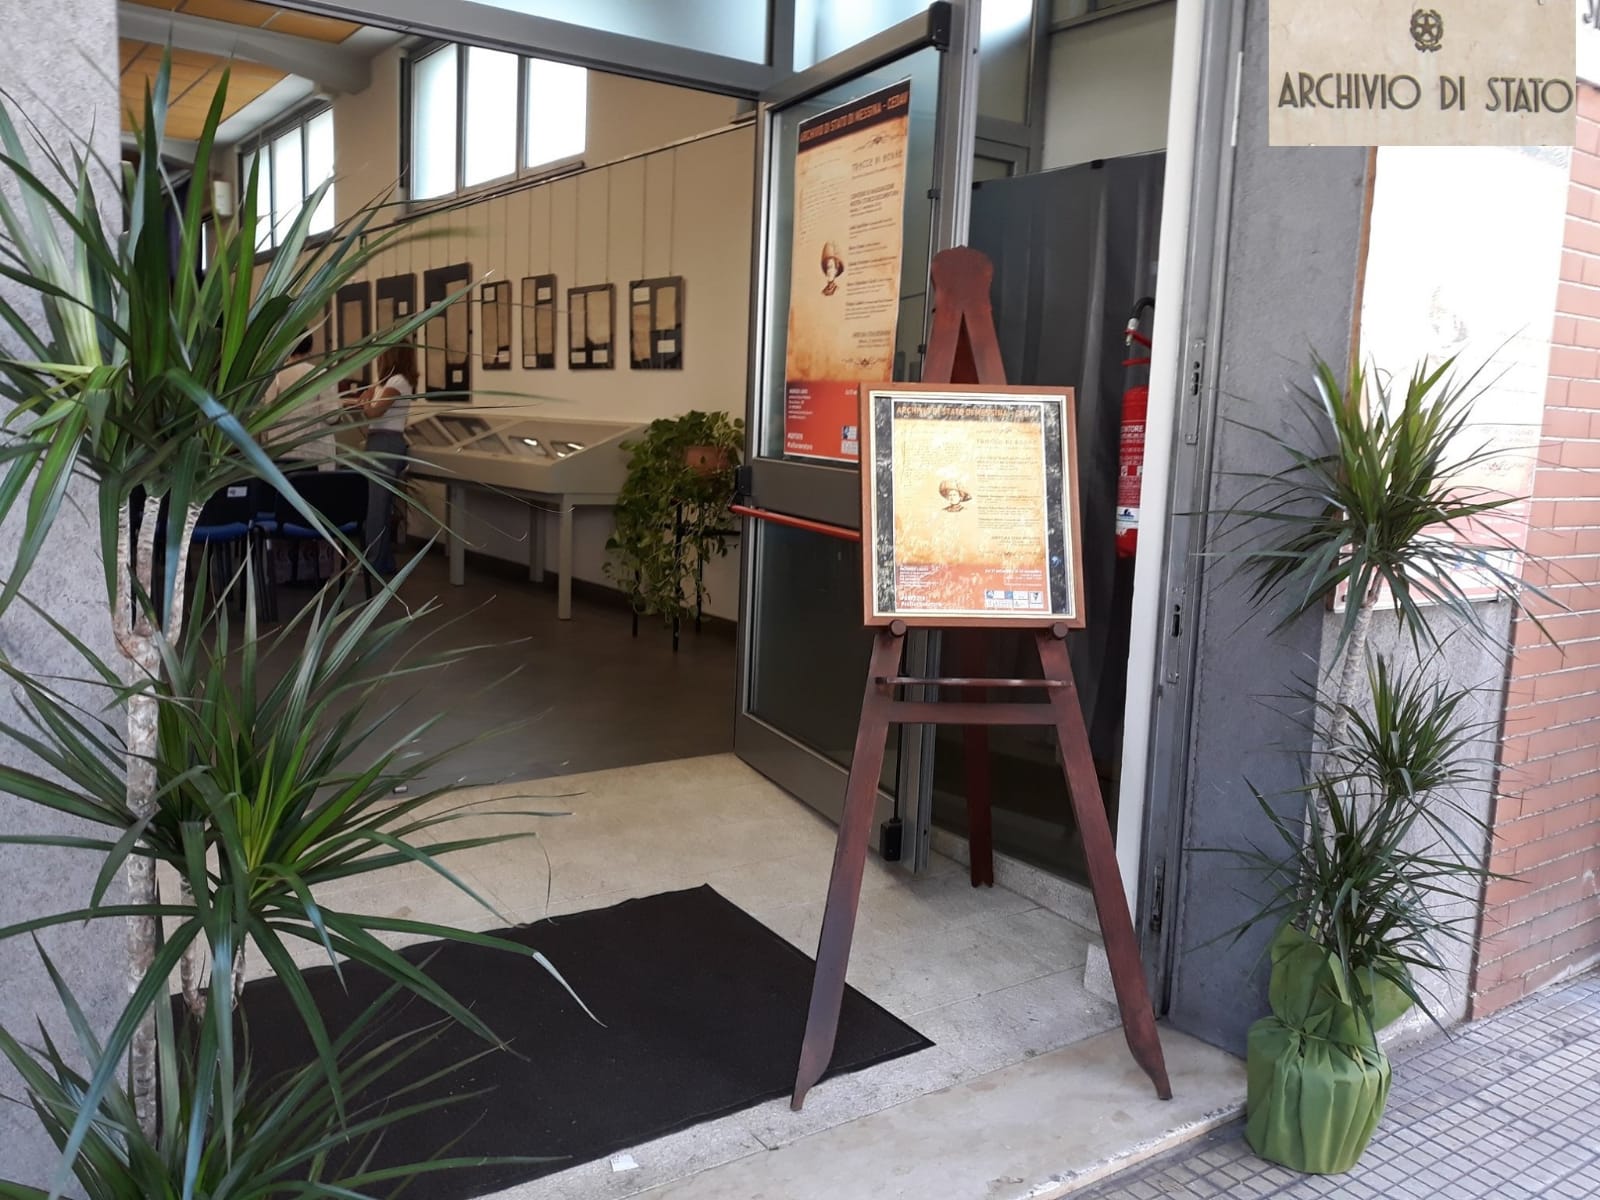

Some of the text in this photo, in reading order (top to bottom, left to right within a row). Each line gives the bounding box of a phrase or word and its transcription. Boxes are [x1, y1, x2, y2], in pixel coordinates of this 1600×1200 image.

[1278, 72, 1574, 113] ARCHIVIO DI STATO
[855, 103, 882, 121] MESSINA
[943, 408, 964, 417] STATO
